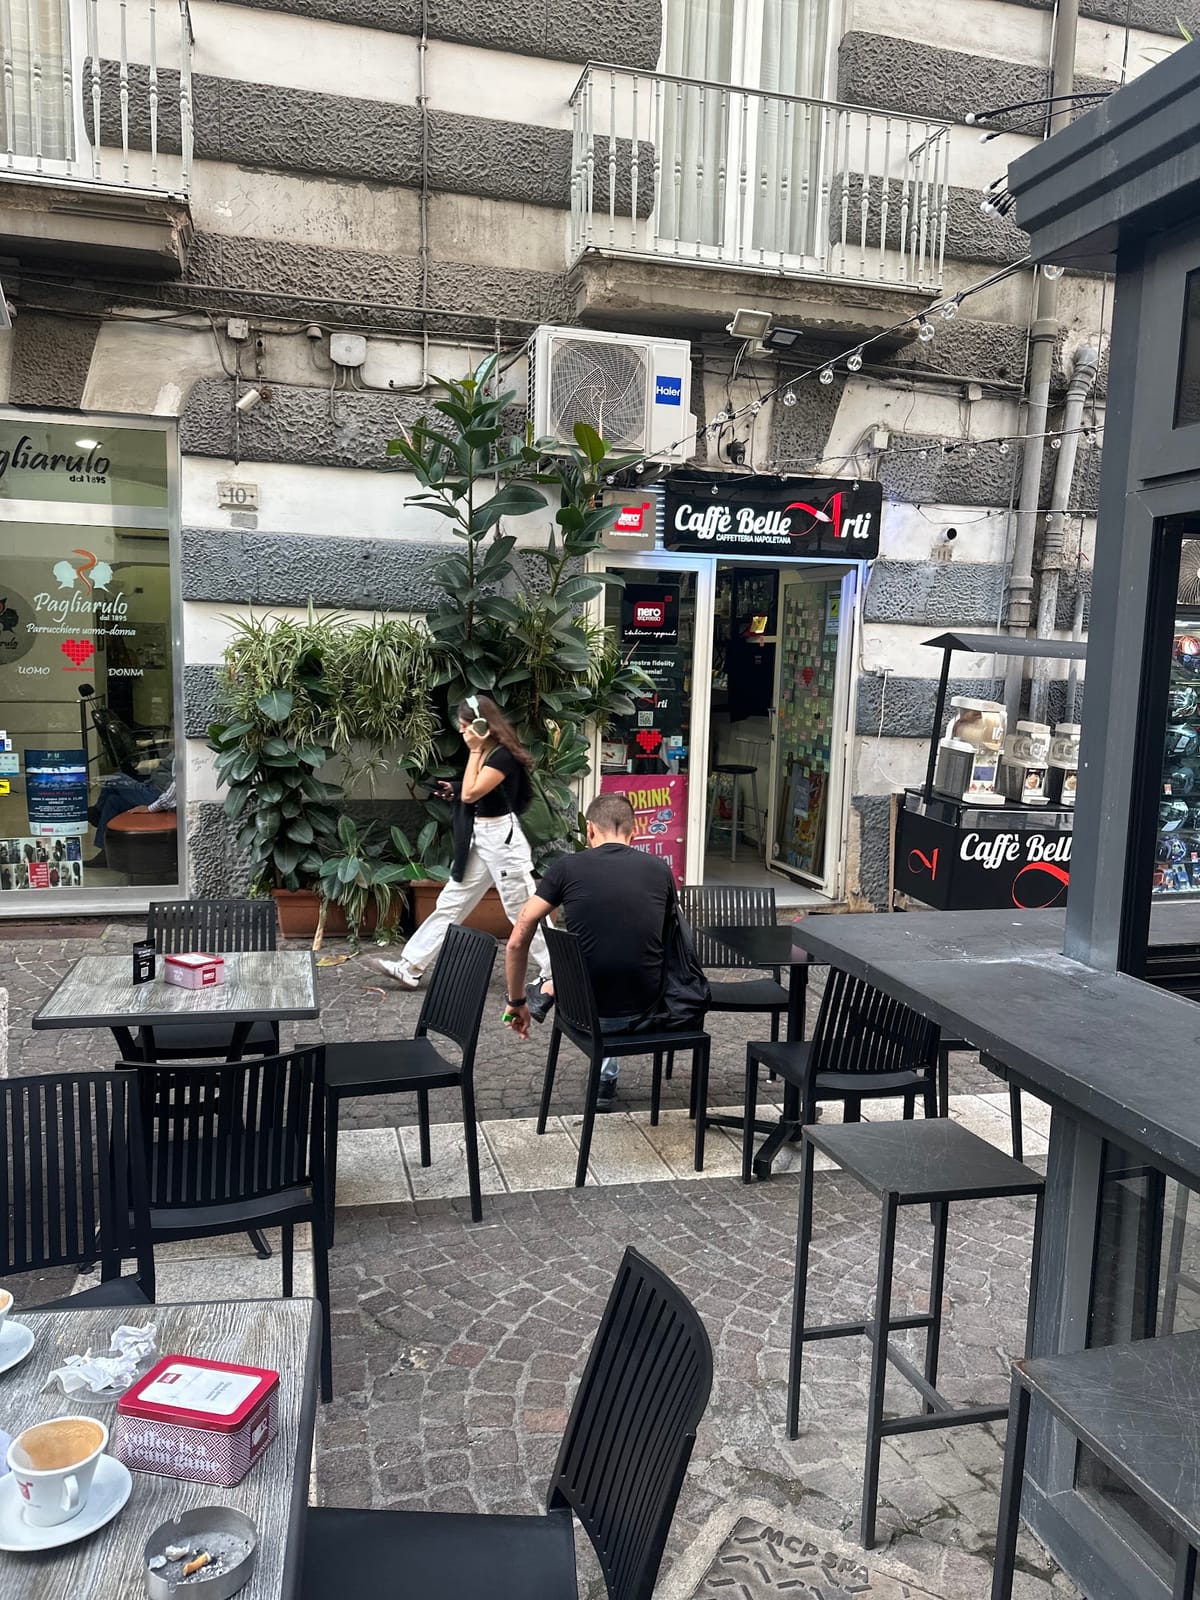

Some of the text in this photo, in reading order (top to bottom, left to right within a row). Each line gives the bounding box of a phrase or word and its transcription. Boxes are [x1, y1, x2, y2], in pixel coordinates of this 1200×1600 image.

[656, 386, 680, 397] Haier
[87, 475, 107, 484] 1895
[228, 487, 247, 504] 10
[674, 504, 732, 540] Caffè
[736, 508, 792, 536] Belle
[716, 533, 791, 545] CAFFETTERIA NAPOLETANA
[33, 590, 128, 622] Pagliarulo
[637, 607, 661, 617] nero
[26, 622, 136, 636] Parrucchiere uomo-donna
[18, 666, 51, 675] UOMO
[652, 660, 675, 668] fidelity
[108, 667, 145, 677] DONNA
[628, 787, 672, 810] DRINK
[960, 833, 1020, 870] Caffè
[760, 1526, 869, 1584] MCP SPA
